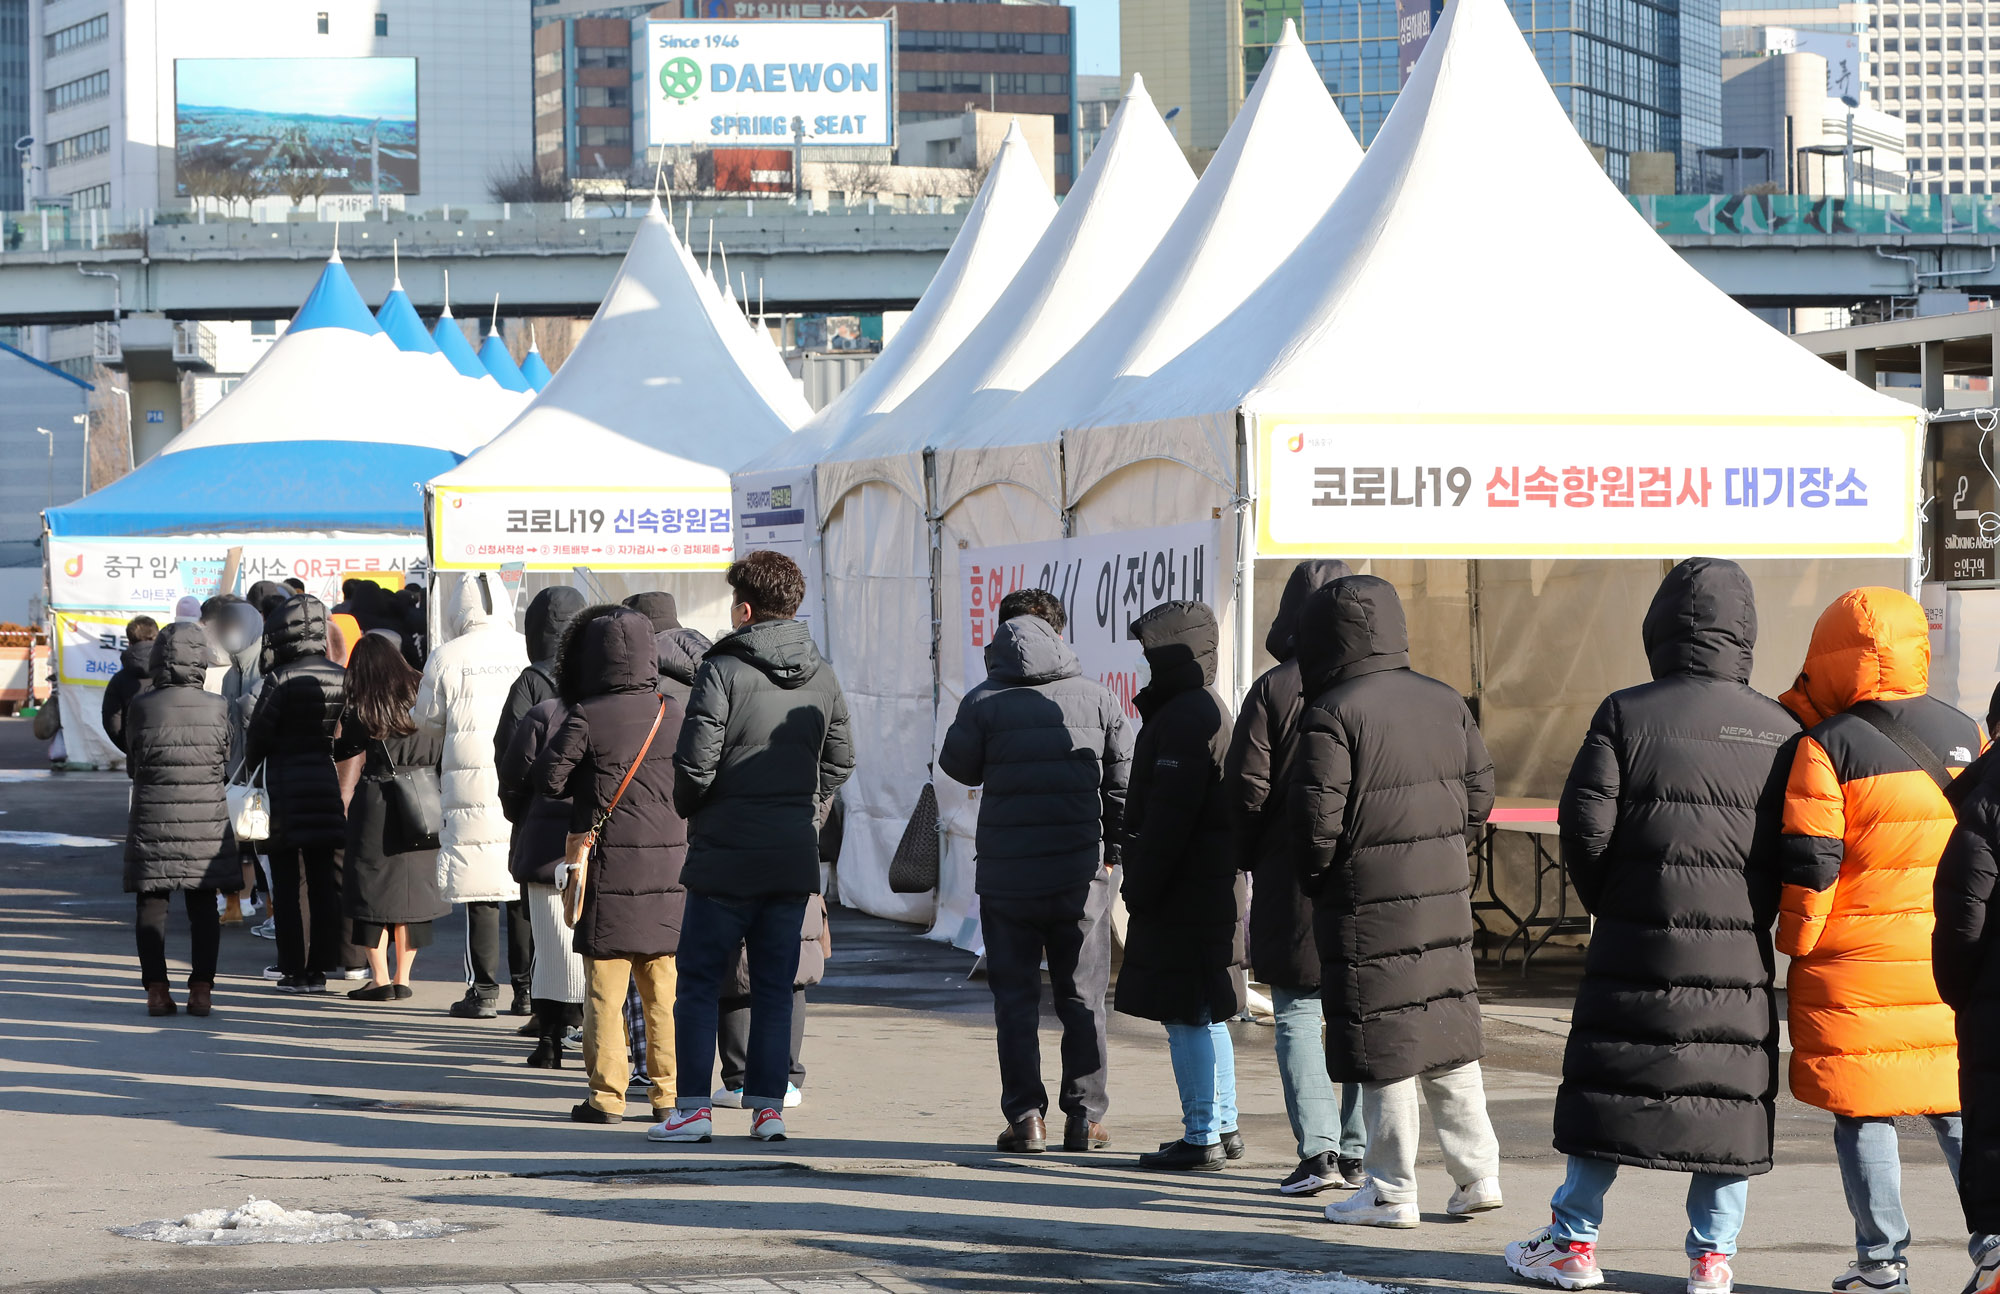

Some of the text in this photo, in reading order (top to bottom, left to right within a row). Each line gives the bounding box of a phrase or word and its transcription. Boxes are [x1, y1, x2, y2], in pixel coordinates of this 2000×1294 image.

[659, 35, 740, 48] Since 1946
[710, 63, 878, 93] DAEWON
[710, 115, 787, 135] SPRING
[814, 115, 867, 134] SEAT
[147, 412, 163, 421] P14
[1312, 465, 1869, 508] 코로나19 신속항원검사 대기장소
[506, 508, 605, 534] 코로나19
[1945, 535, 1994, 549] SMOKING AREA
[478, 544, 525, 555] 신청서작성
[553, 544, 590, 555] 키트배부
[618, 544, 655, 555] 자가검사
[104, 556, 144, 578] 중구
[130, 588, 177, 601] 스마트폰
[1720, 725, 1753, 737] NEPA
